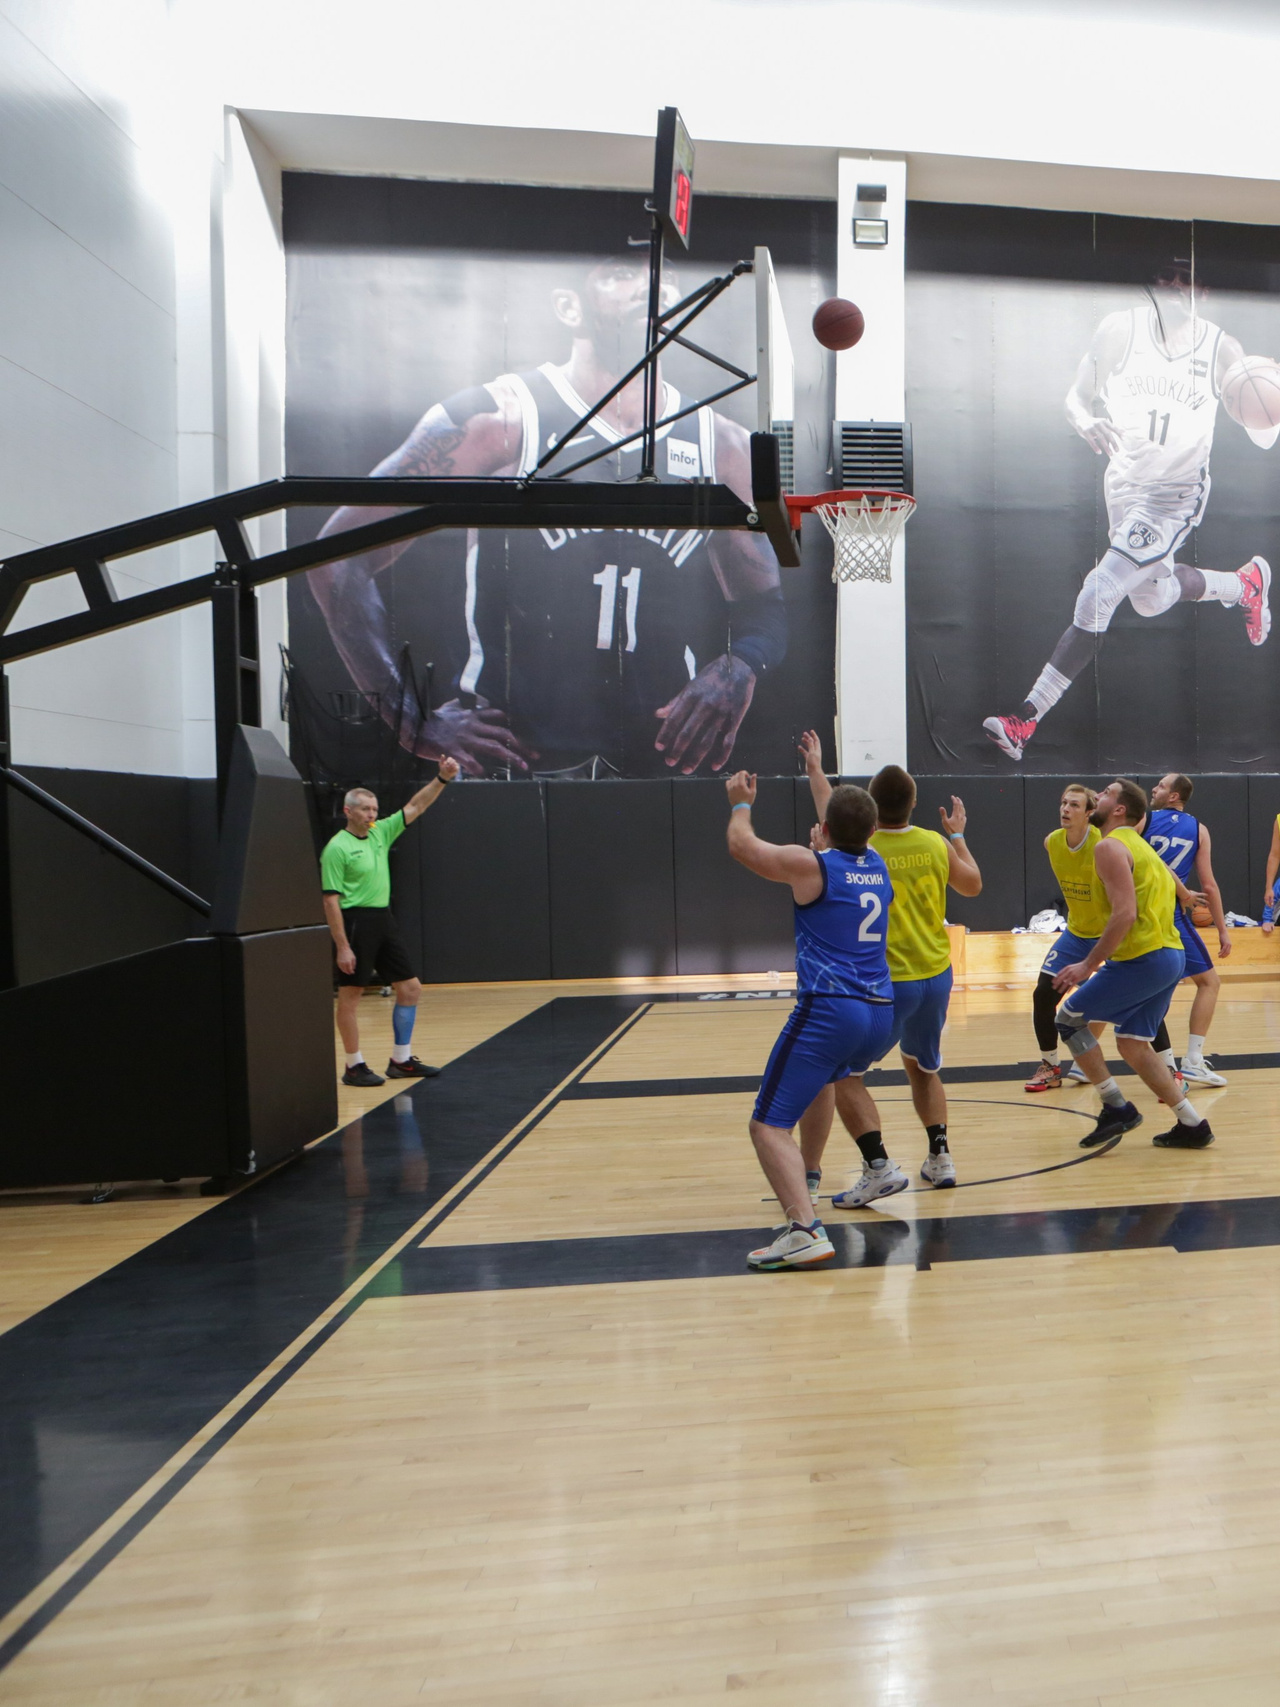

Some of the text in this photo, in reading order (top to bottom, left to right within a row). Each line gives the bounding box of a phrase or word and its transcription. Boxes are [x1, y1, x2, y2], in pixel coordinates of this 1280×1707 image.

[1125, 375, 1208, 411] BROOKLYN
[1147, 409, 1171, 446] 11
[670, 449, 697, 466] infor
[1130, 522, 1156, 545] NETS
[593, 564, 641, 653] 11
[1150, 835, 1195, 870] 27
[845, 871, 884, 885] ЗЮКИН
[858, 892, 882, 942] 2
